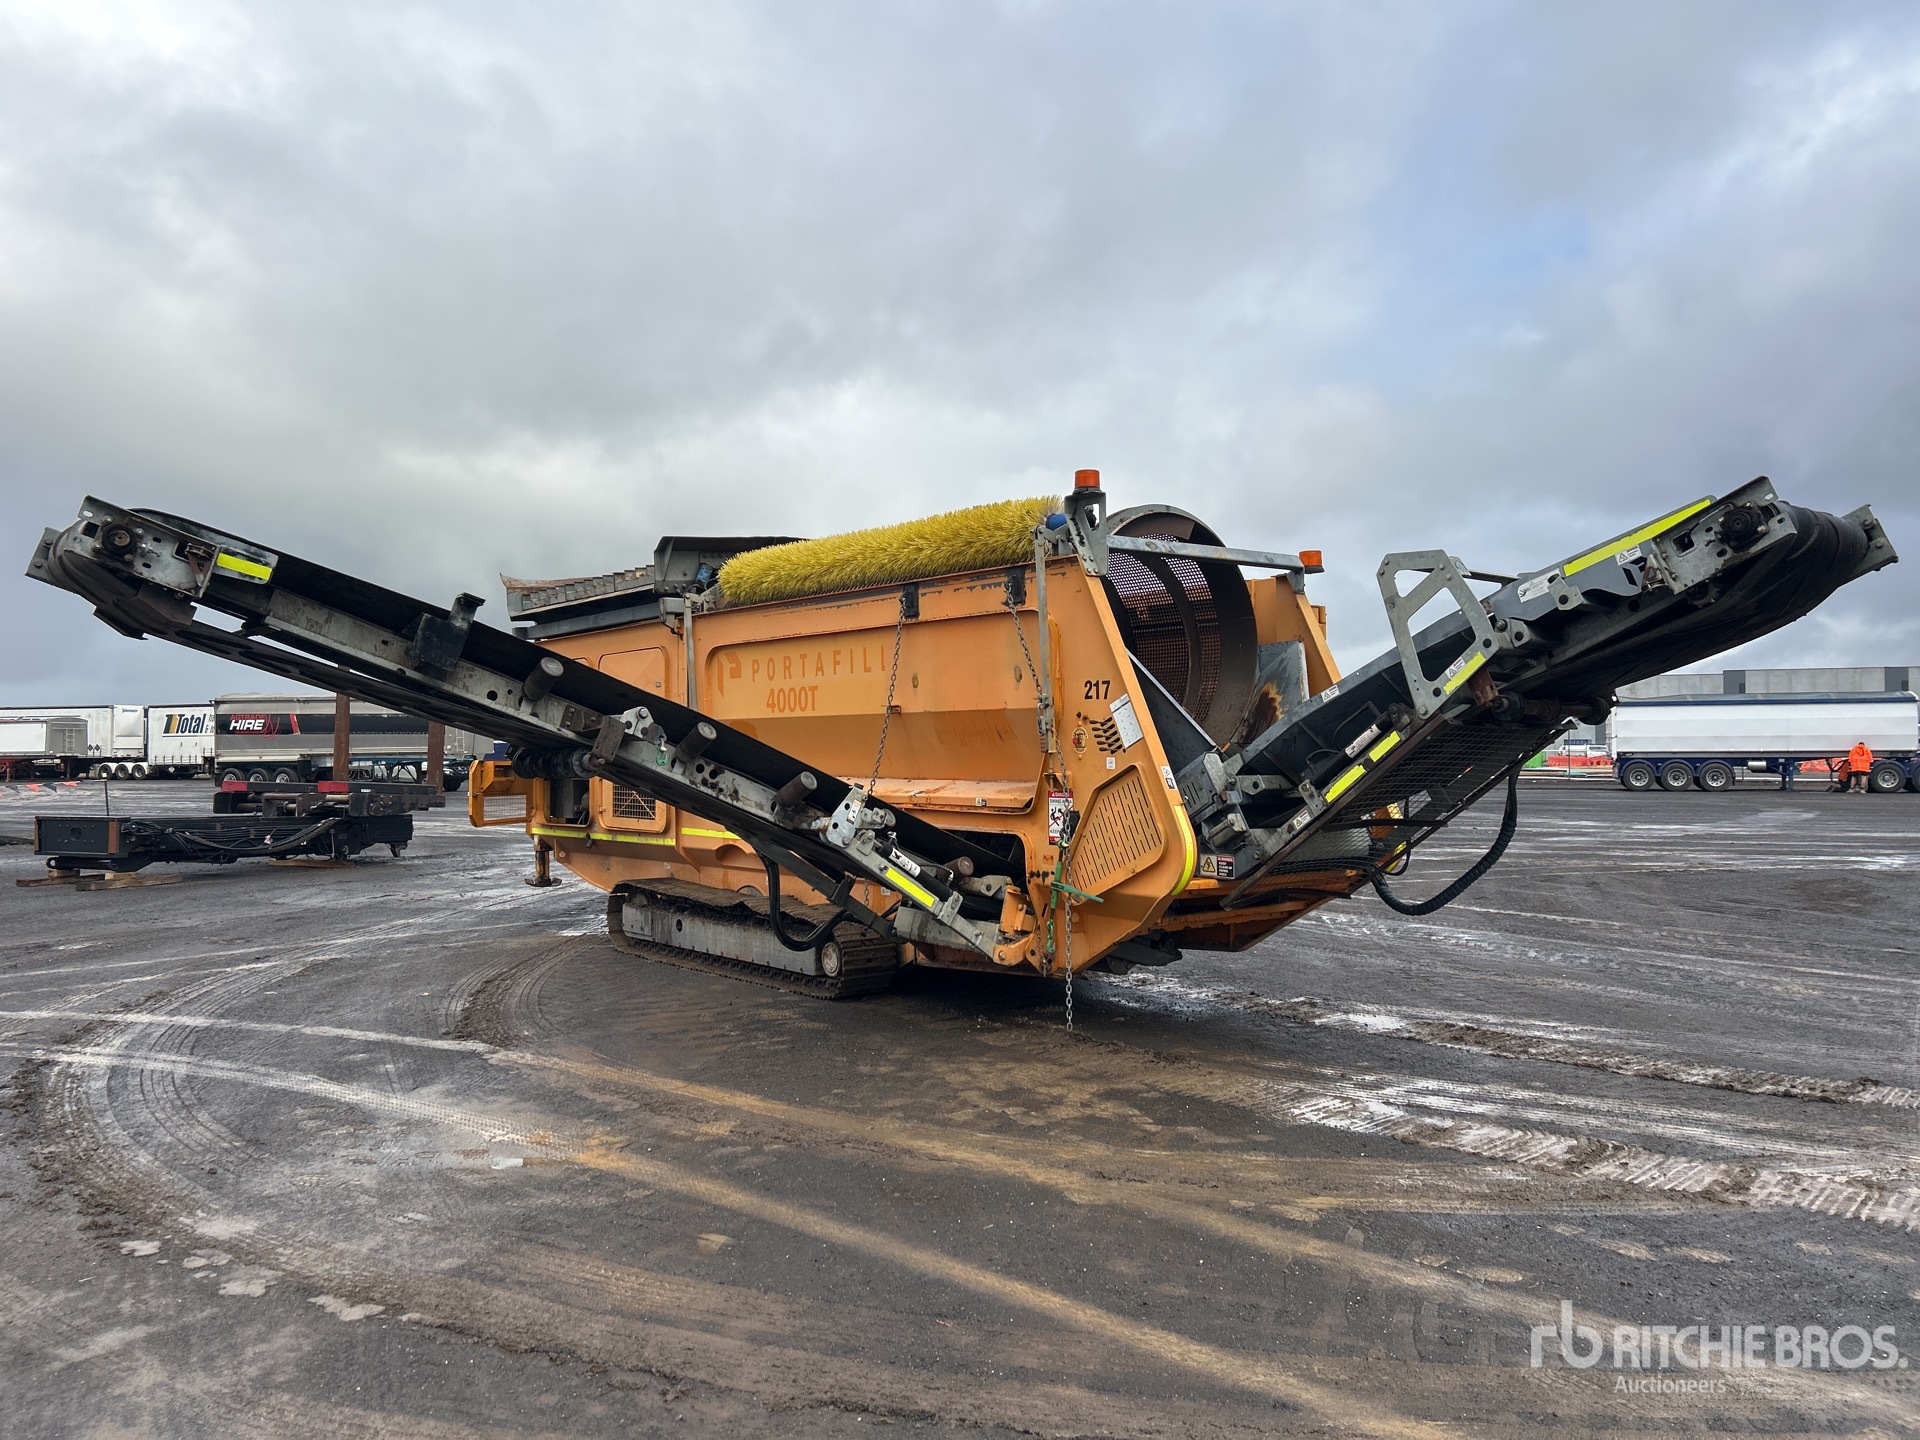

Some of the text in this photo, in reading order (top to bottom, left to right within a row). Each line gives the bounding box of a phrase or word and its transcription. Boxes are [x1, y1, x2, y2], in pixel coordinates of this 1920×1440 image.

[766, 685, 819, 713] 4000T
[1084, 680, 1111, 700] 217
[176, 713, 207, 734] Total
[229, 719, 265, 731] HIRE
